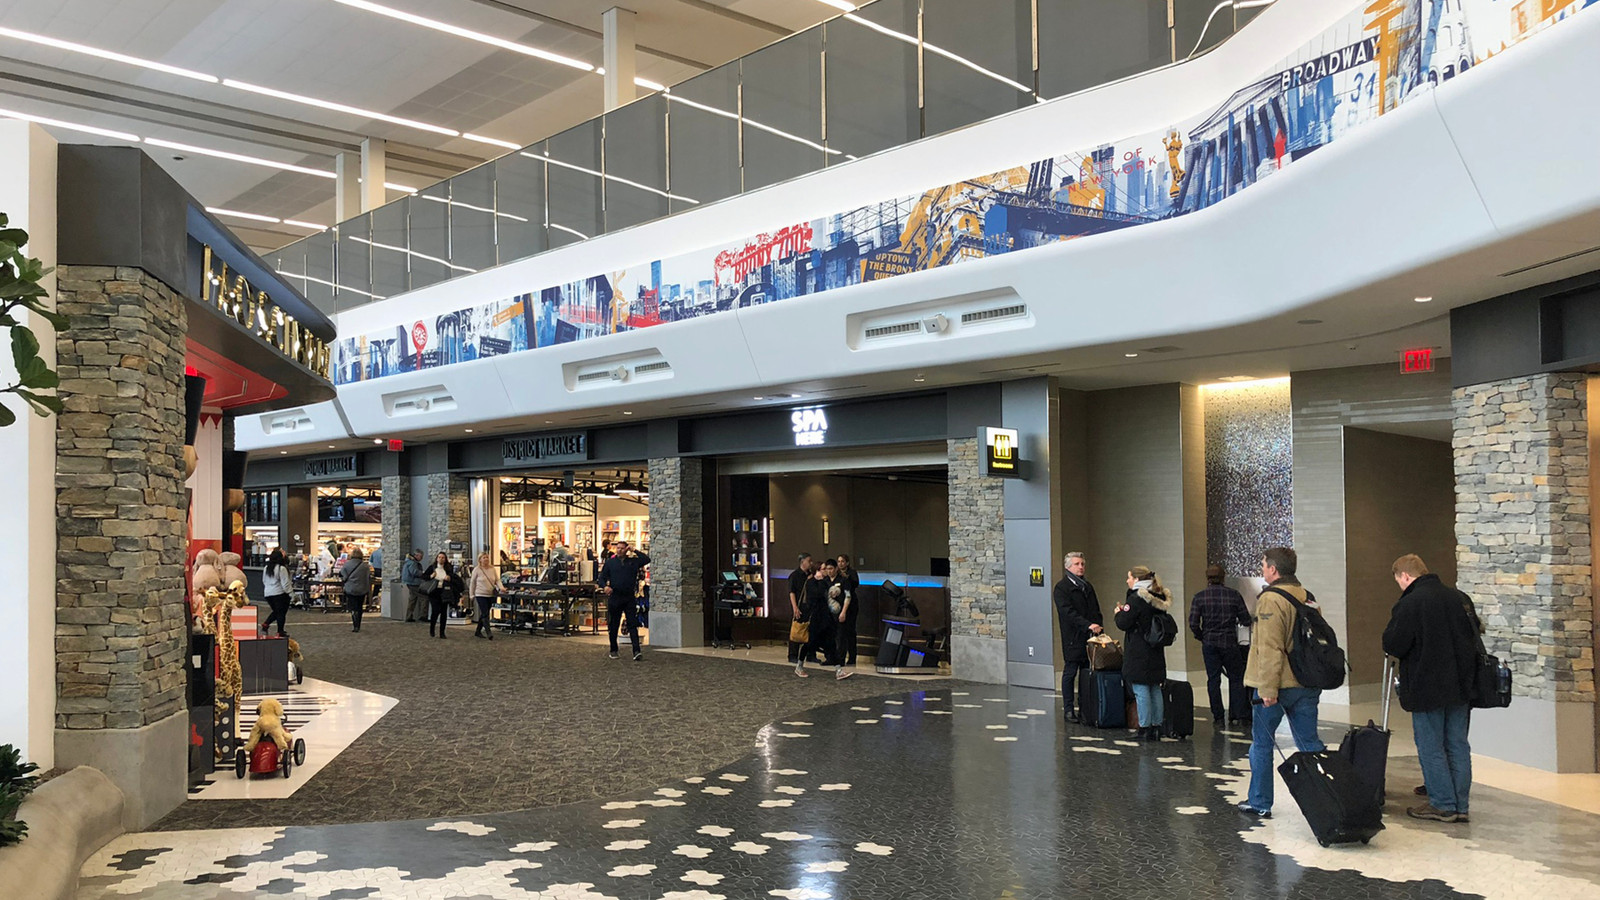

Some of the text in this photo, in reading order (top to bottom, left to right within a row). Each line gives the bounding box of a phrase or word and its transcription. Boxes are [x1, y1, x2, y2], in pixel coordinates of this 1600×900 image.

[1280, 36, 1381, 92] BROADWAY
[1123, 146, 1143, 162] OF
[1067, 155, 1158, 194] NEW YORK
[869, 260, 914, 274] THE BRONX
[875, 252, 910, 265] UPTOWN
[1404, 349, 1432, 372] EXIT
[791, 408, 828, 433] SPA
[540, 434, 586, 457] MARKET
